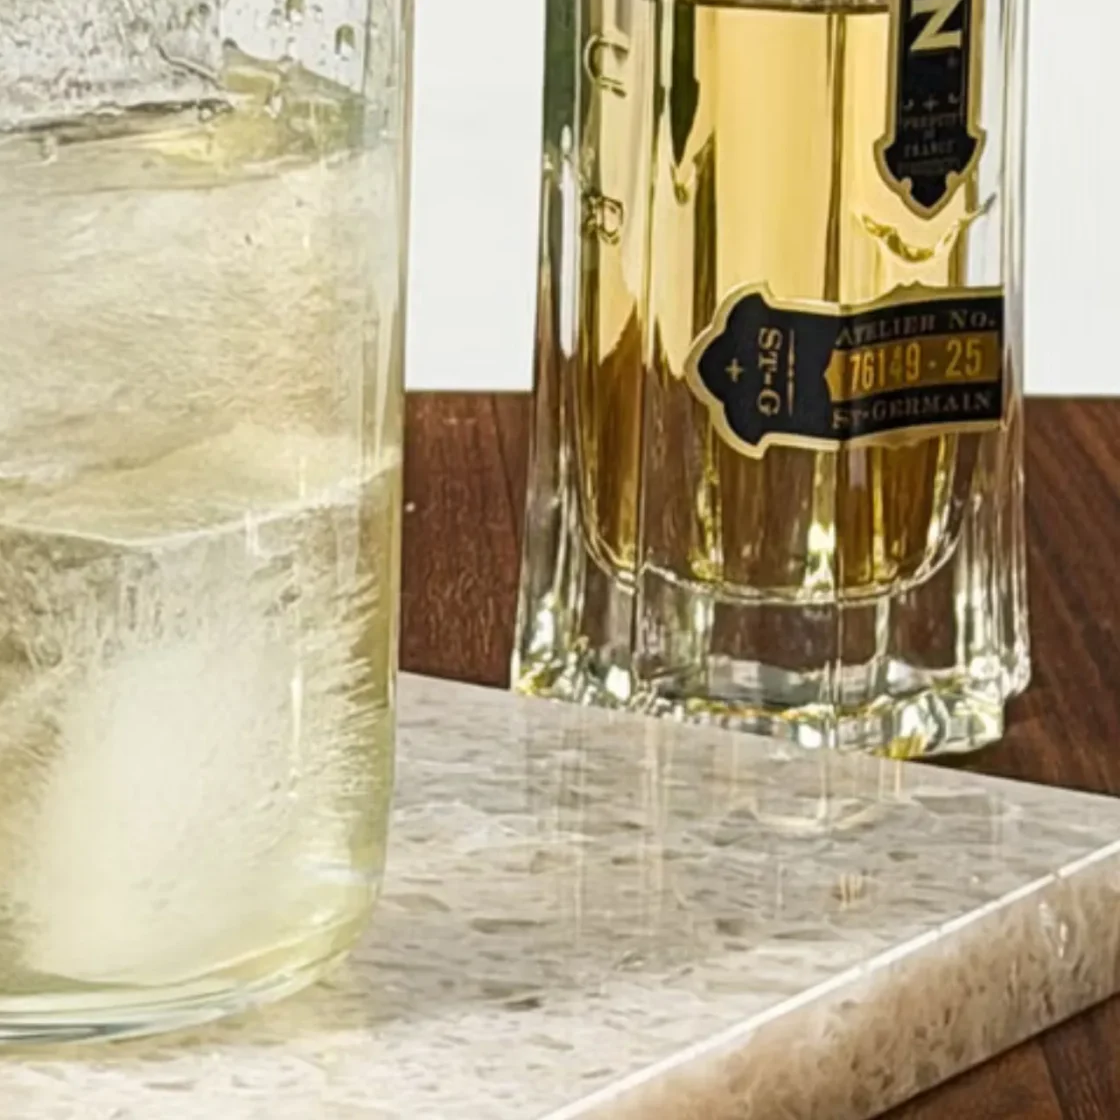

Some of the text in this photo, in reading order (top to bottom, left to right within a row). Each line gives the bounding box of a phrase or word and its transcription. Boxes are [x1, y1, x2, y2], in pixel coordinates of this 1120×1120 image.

[834, 314, 937, 348] ATELIER
[757, 327, 784, 418] ST-G
[849, 336, 984, 393] 76149 25
